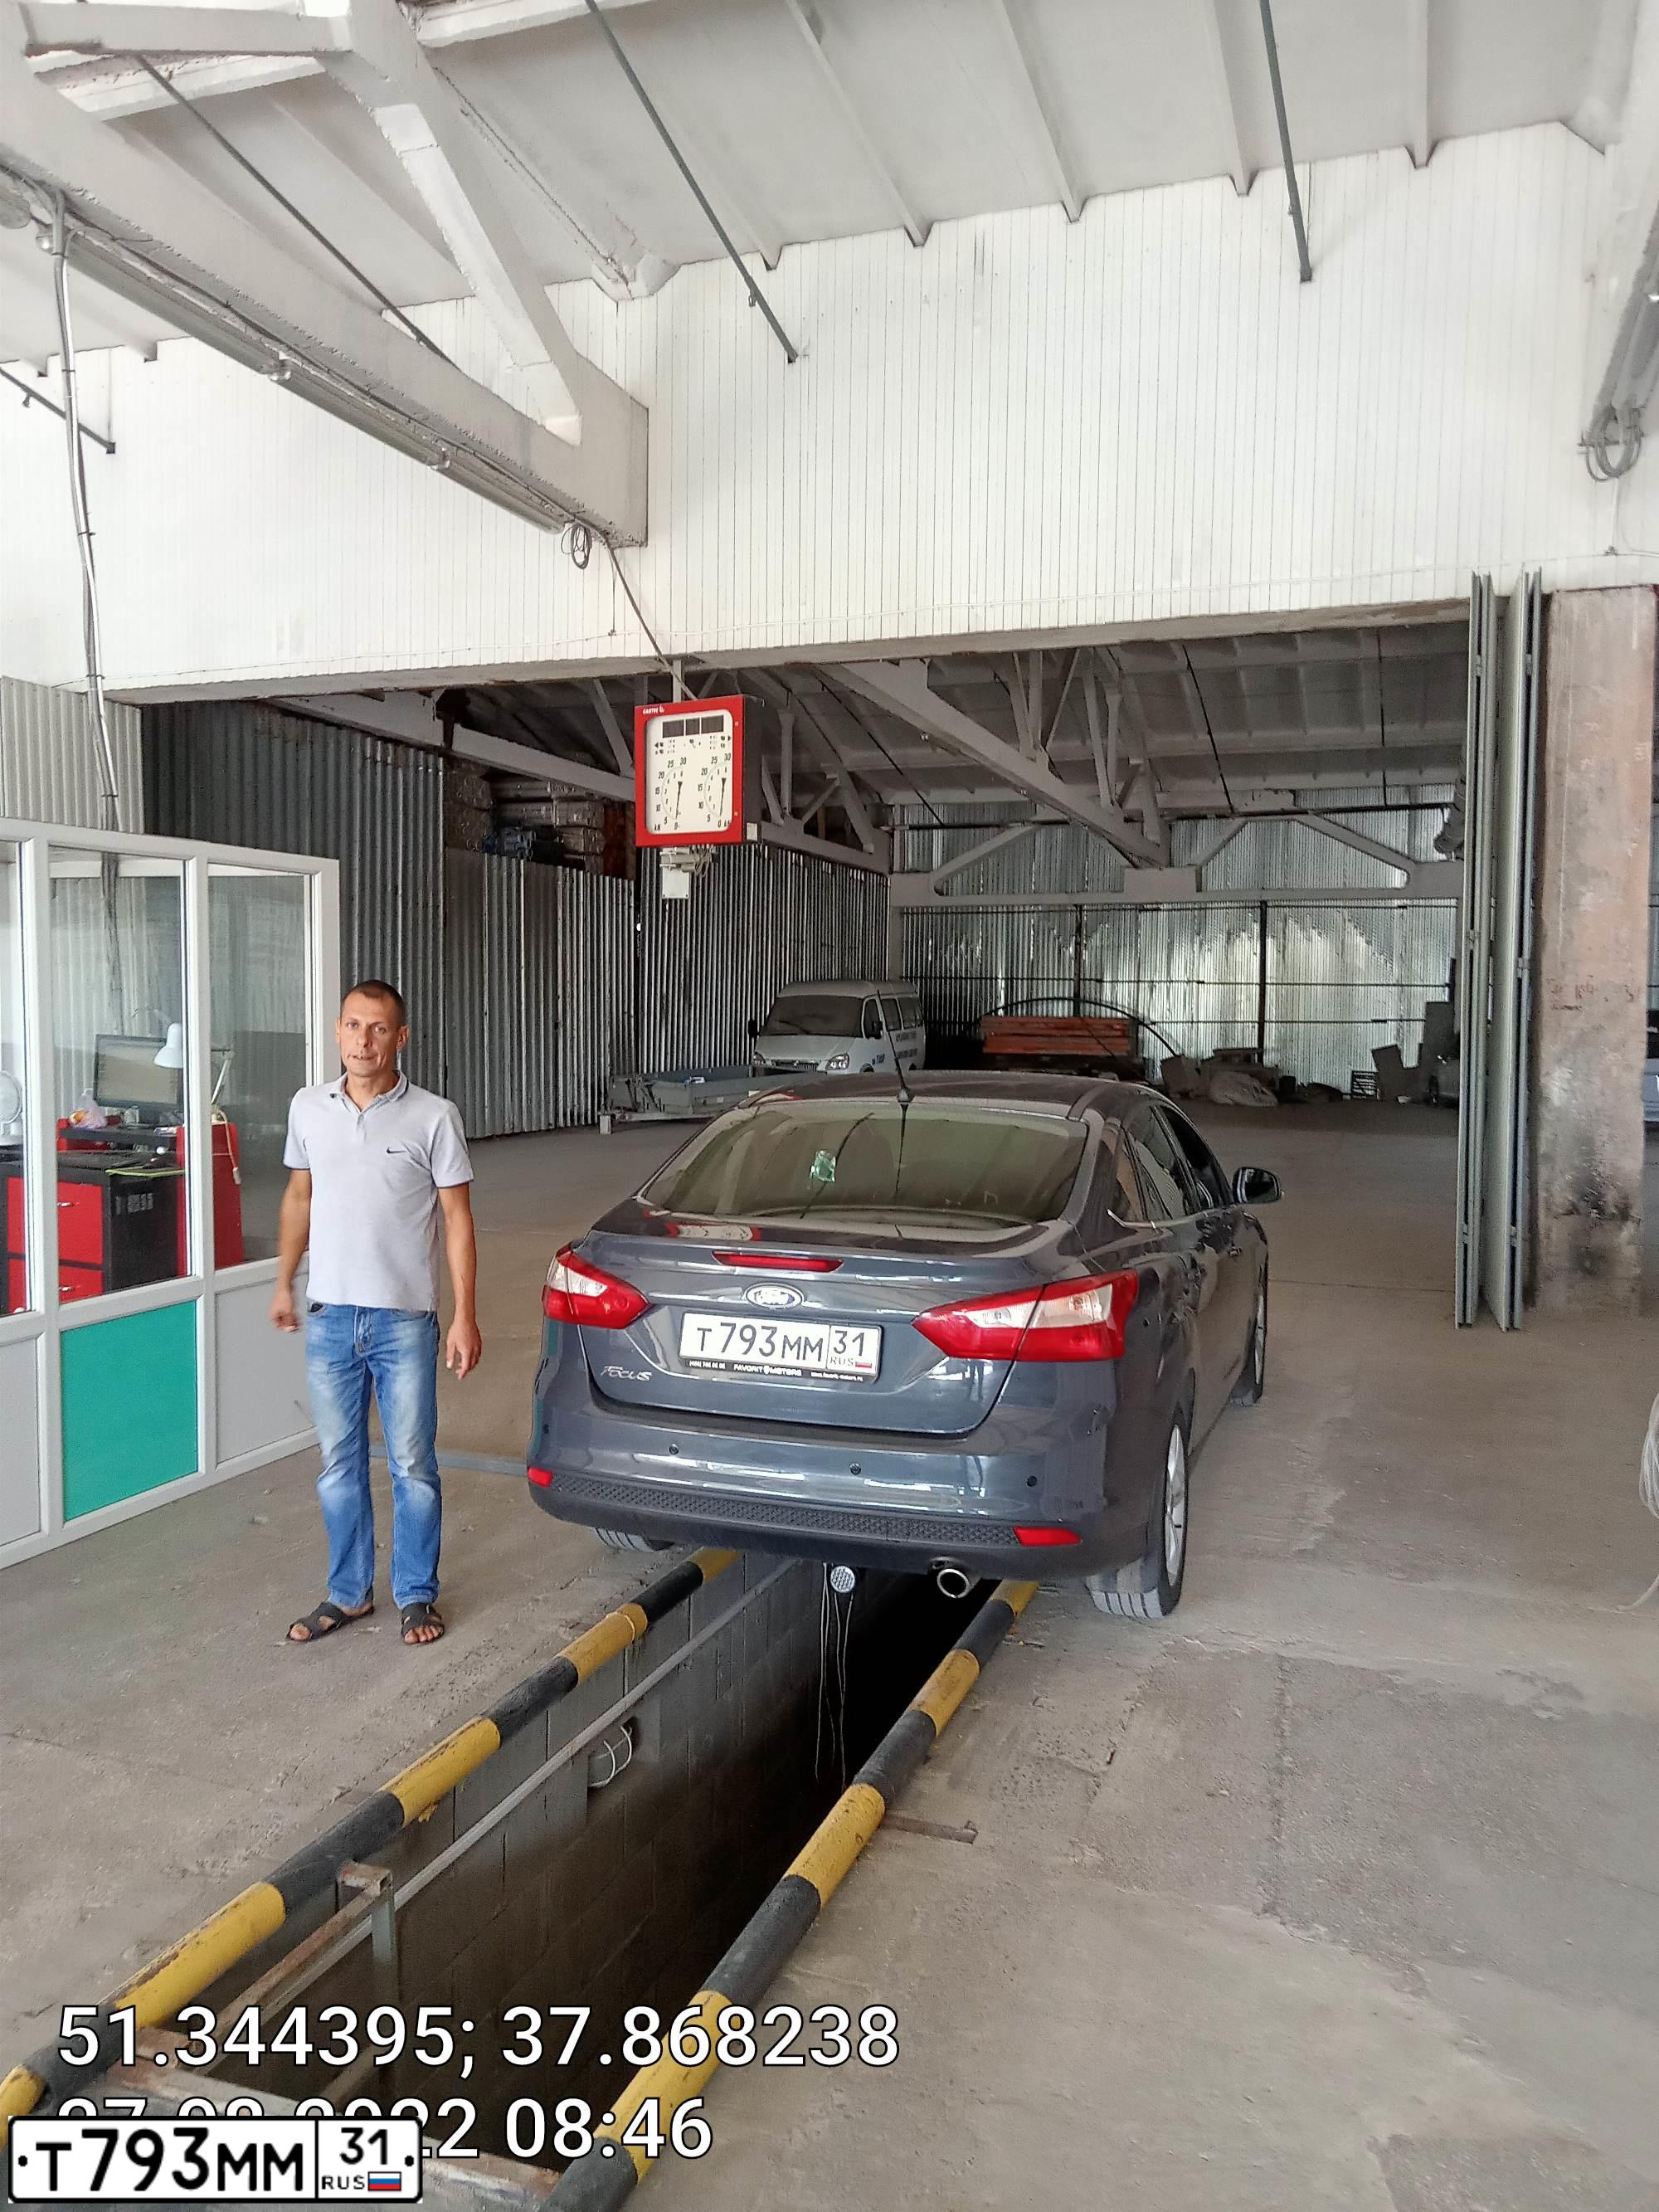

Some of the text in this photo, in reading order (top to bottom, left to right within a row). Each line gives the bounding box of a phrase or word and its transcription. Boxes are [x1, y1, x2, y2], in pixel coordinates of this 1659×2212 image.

[697, 1322, 865, 1362] T793MM 31
[830, 1356, 854, 1367] RUS
[733, 1364, 763, 1373] FAVORIT
